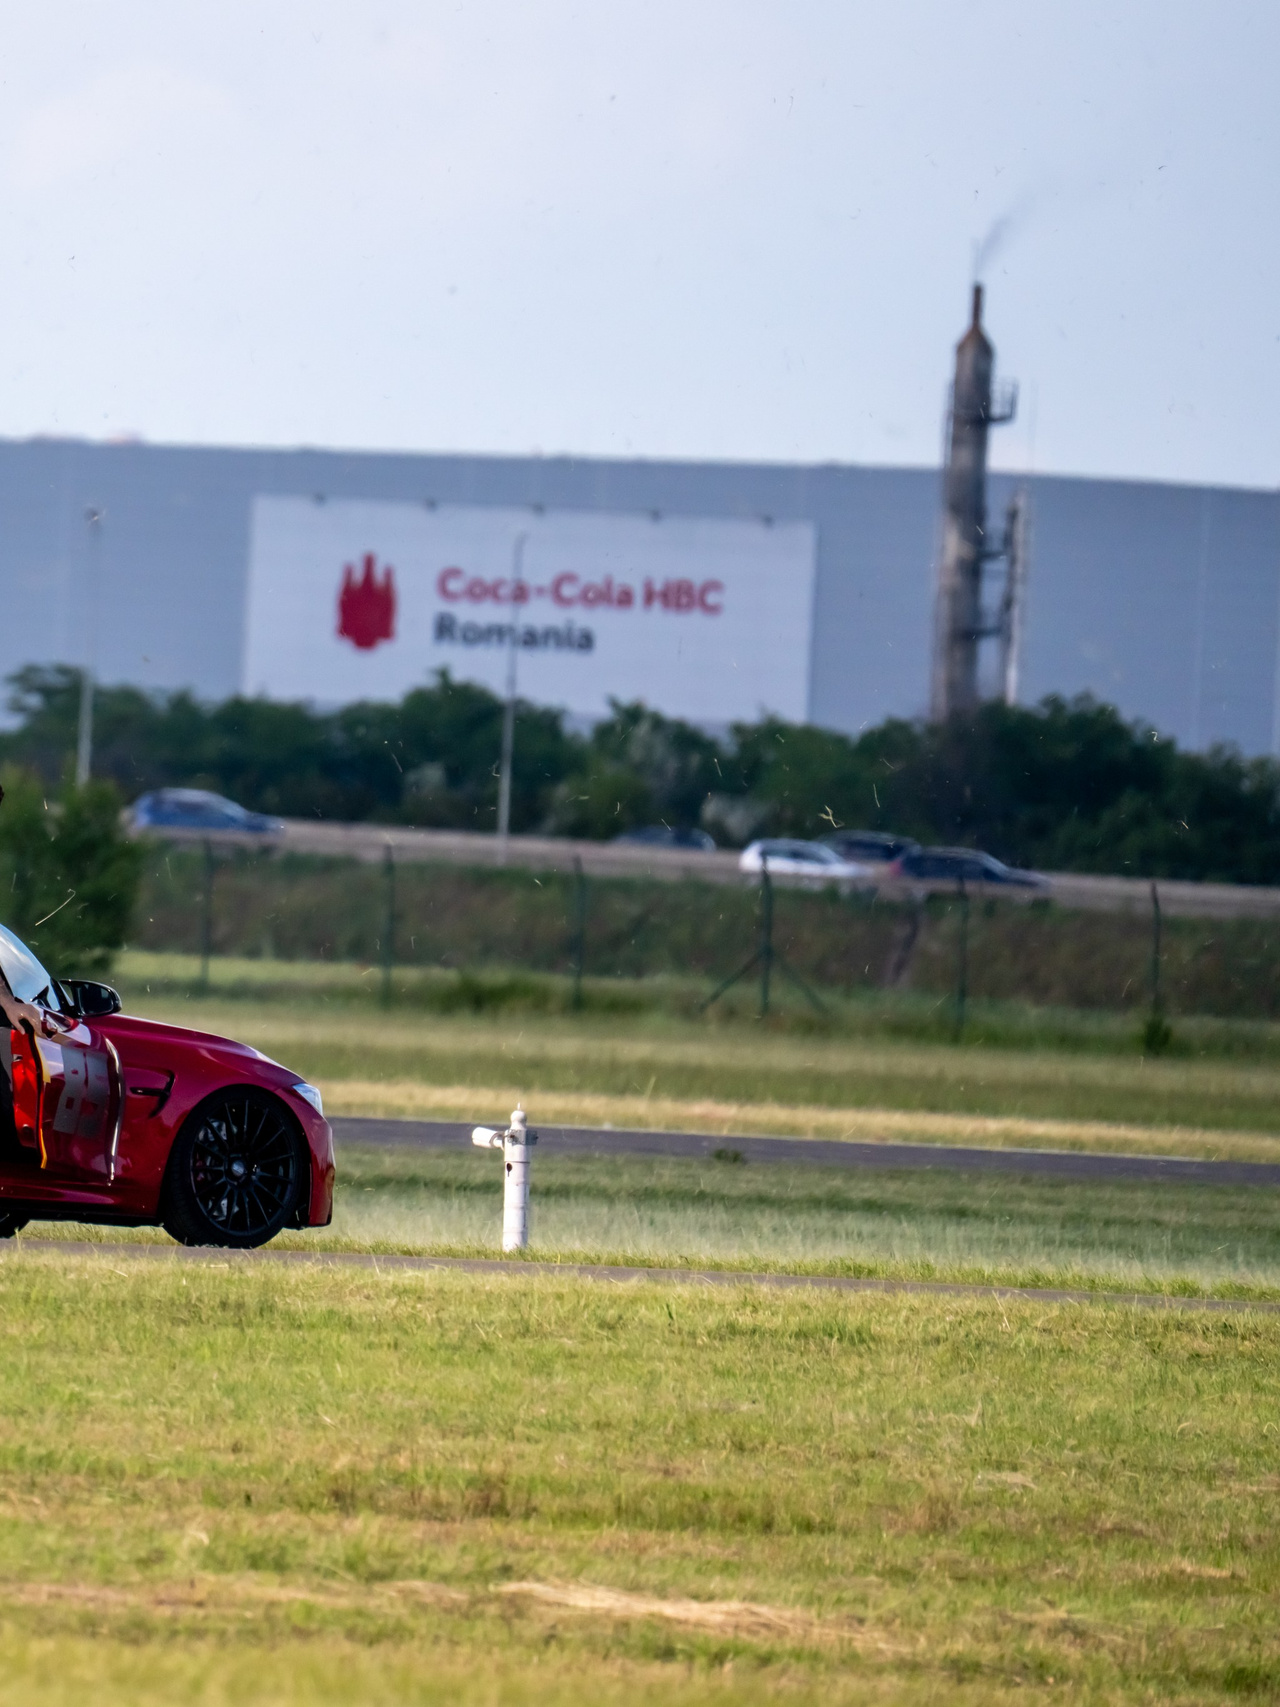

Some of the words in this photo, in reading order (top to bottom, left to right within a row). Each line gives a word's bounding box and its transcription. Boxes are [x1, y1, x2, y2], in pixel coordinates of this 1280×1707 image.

[436, 566, 634, 611] Coca-Cola
[643, 576, 726, 617] HBC
[434, 611, 595, 653] Romania
